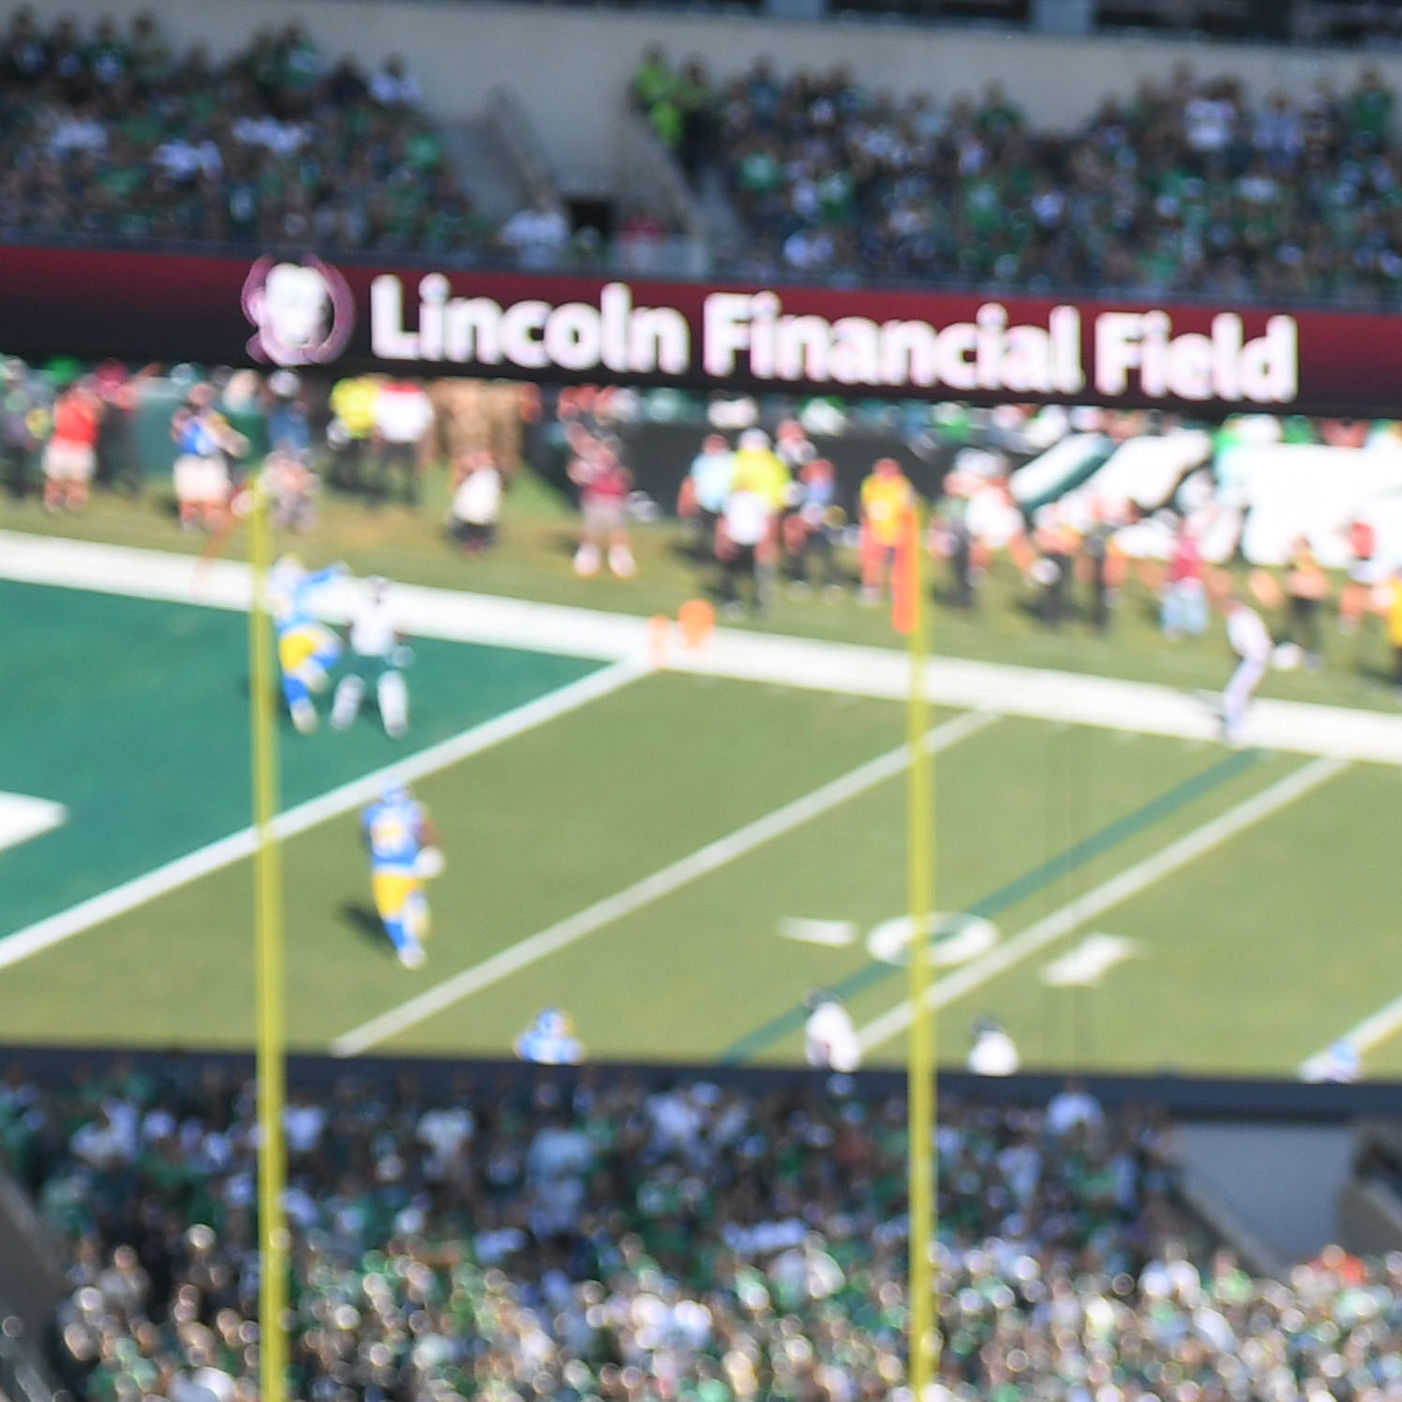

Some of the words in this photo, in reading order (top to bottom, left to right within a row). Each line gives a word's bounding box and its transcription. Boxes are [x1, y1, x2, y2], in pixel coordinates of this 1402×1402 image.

[370, 274, 688, 374] Lincoln
[703, 290, 1083, 394] Financial
[1094, 311, 1298, 402] Field
